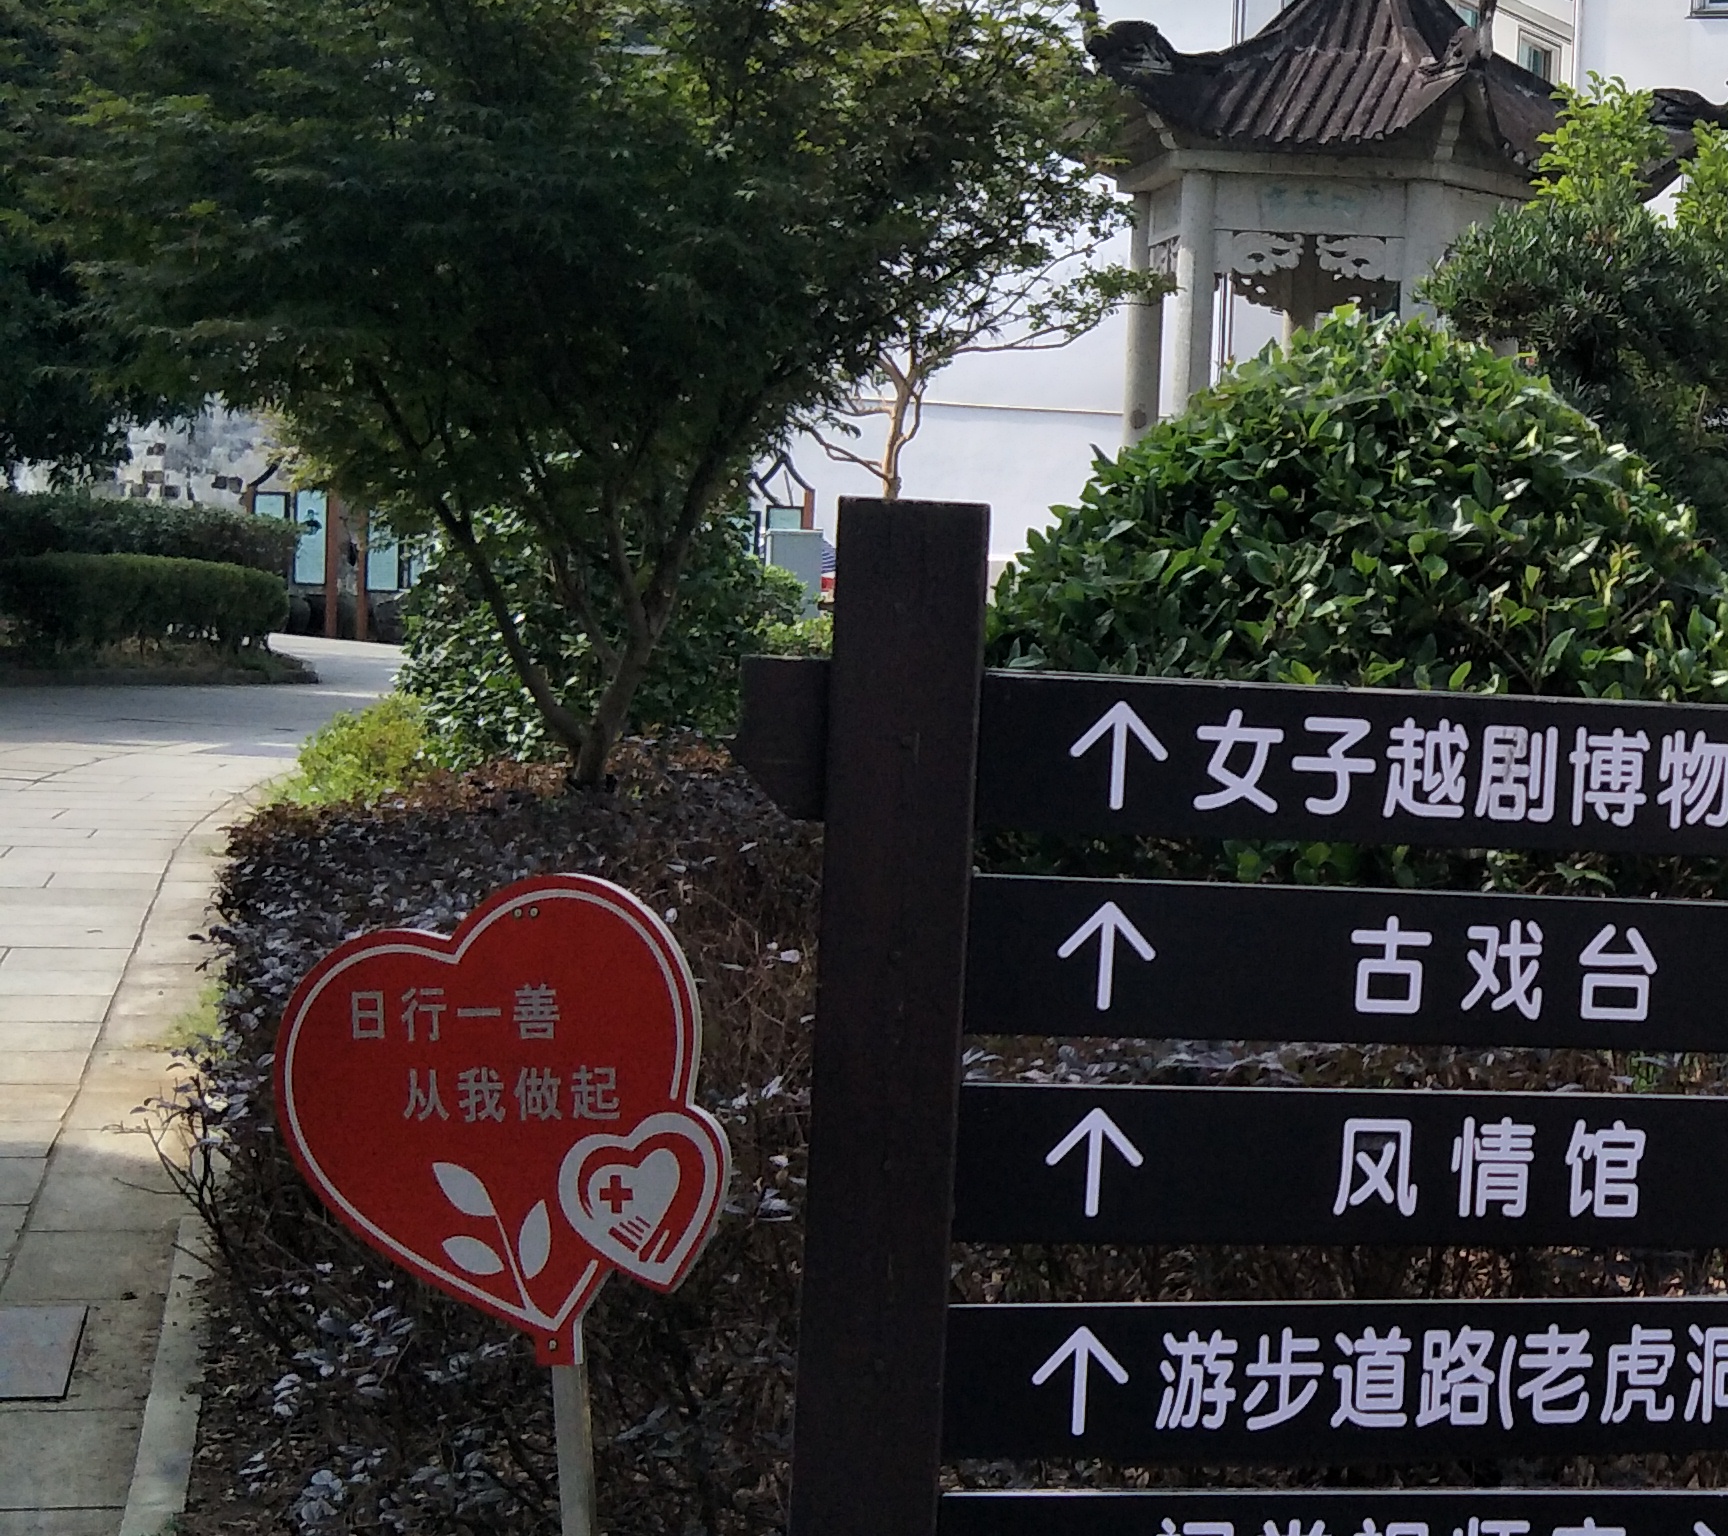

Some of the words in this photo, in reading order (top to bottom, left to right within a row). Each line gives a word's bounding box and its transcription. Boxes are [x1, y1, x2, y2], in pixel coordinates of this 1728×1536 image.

[1351, 915, 1658, 1021] 古戏台
[351, 983, 560, 1042] 日行一善
[403, 1064, 621, 1123] 从我做起
[1333, 1116, 1646, 1218] 风情馆
